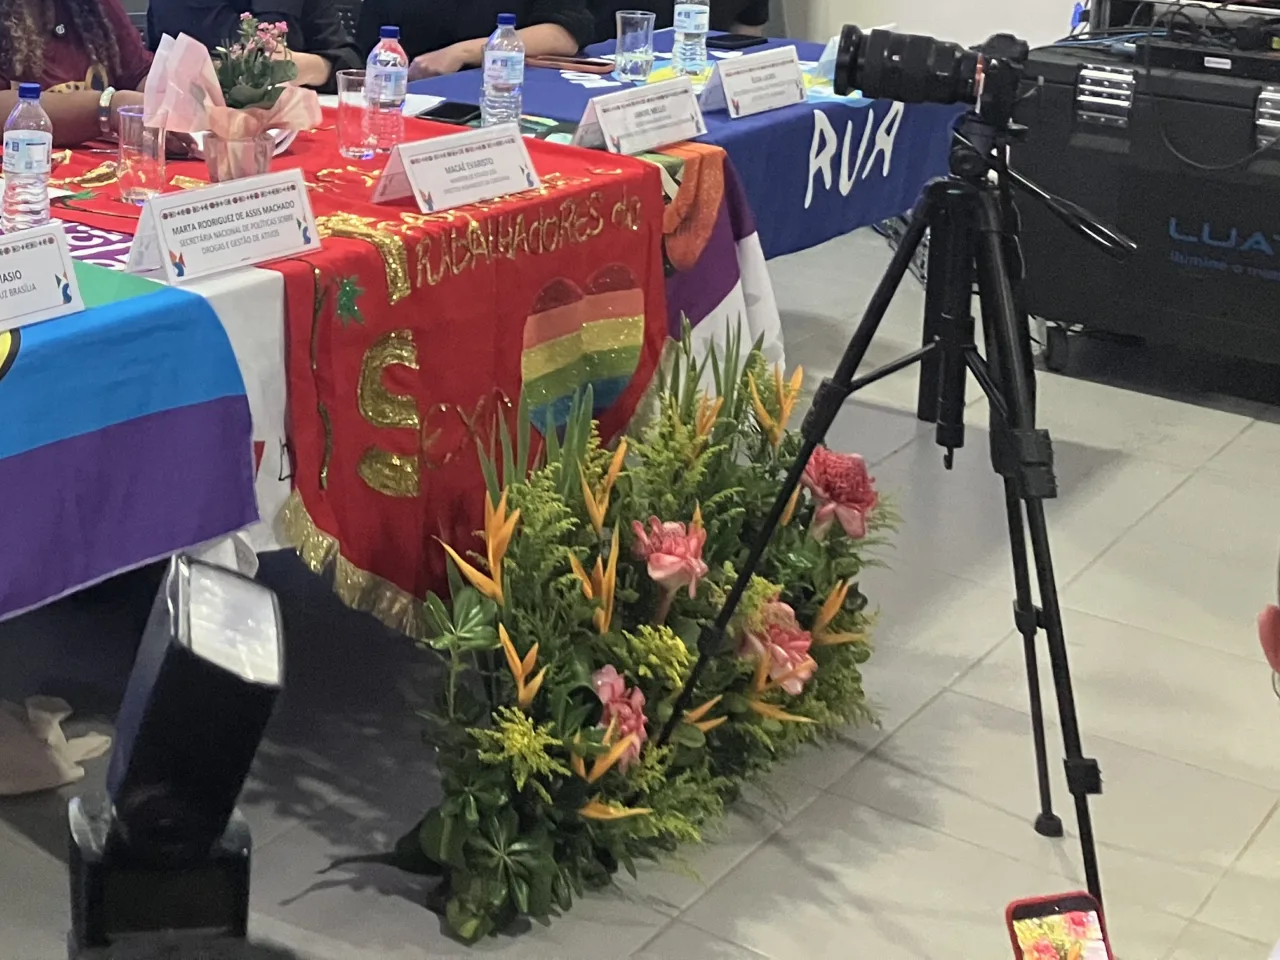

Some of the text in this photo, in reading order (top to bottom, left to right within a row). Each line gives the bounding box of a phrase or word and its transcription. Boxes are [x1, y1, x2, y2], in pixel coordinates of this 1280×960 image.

[804, 101, 905, 209] RUA
[172, 200, 295, 236] MARTA RODRIGUEZ DE ASSIS MACHADO
[179, 231, 213, 248] SECRETÁRIA
[213, 227, 242, 240] NACIONAL
[242, 223, 251, 232] DE
[201, 243, 226, 255] DROGAS
[230, 235, 253, 249] GESTÃO
[253, 234, 261, 243] DE
[1169, 217, 1280, 256] LUA
